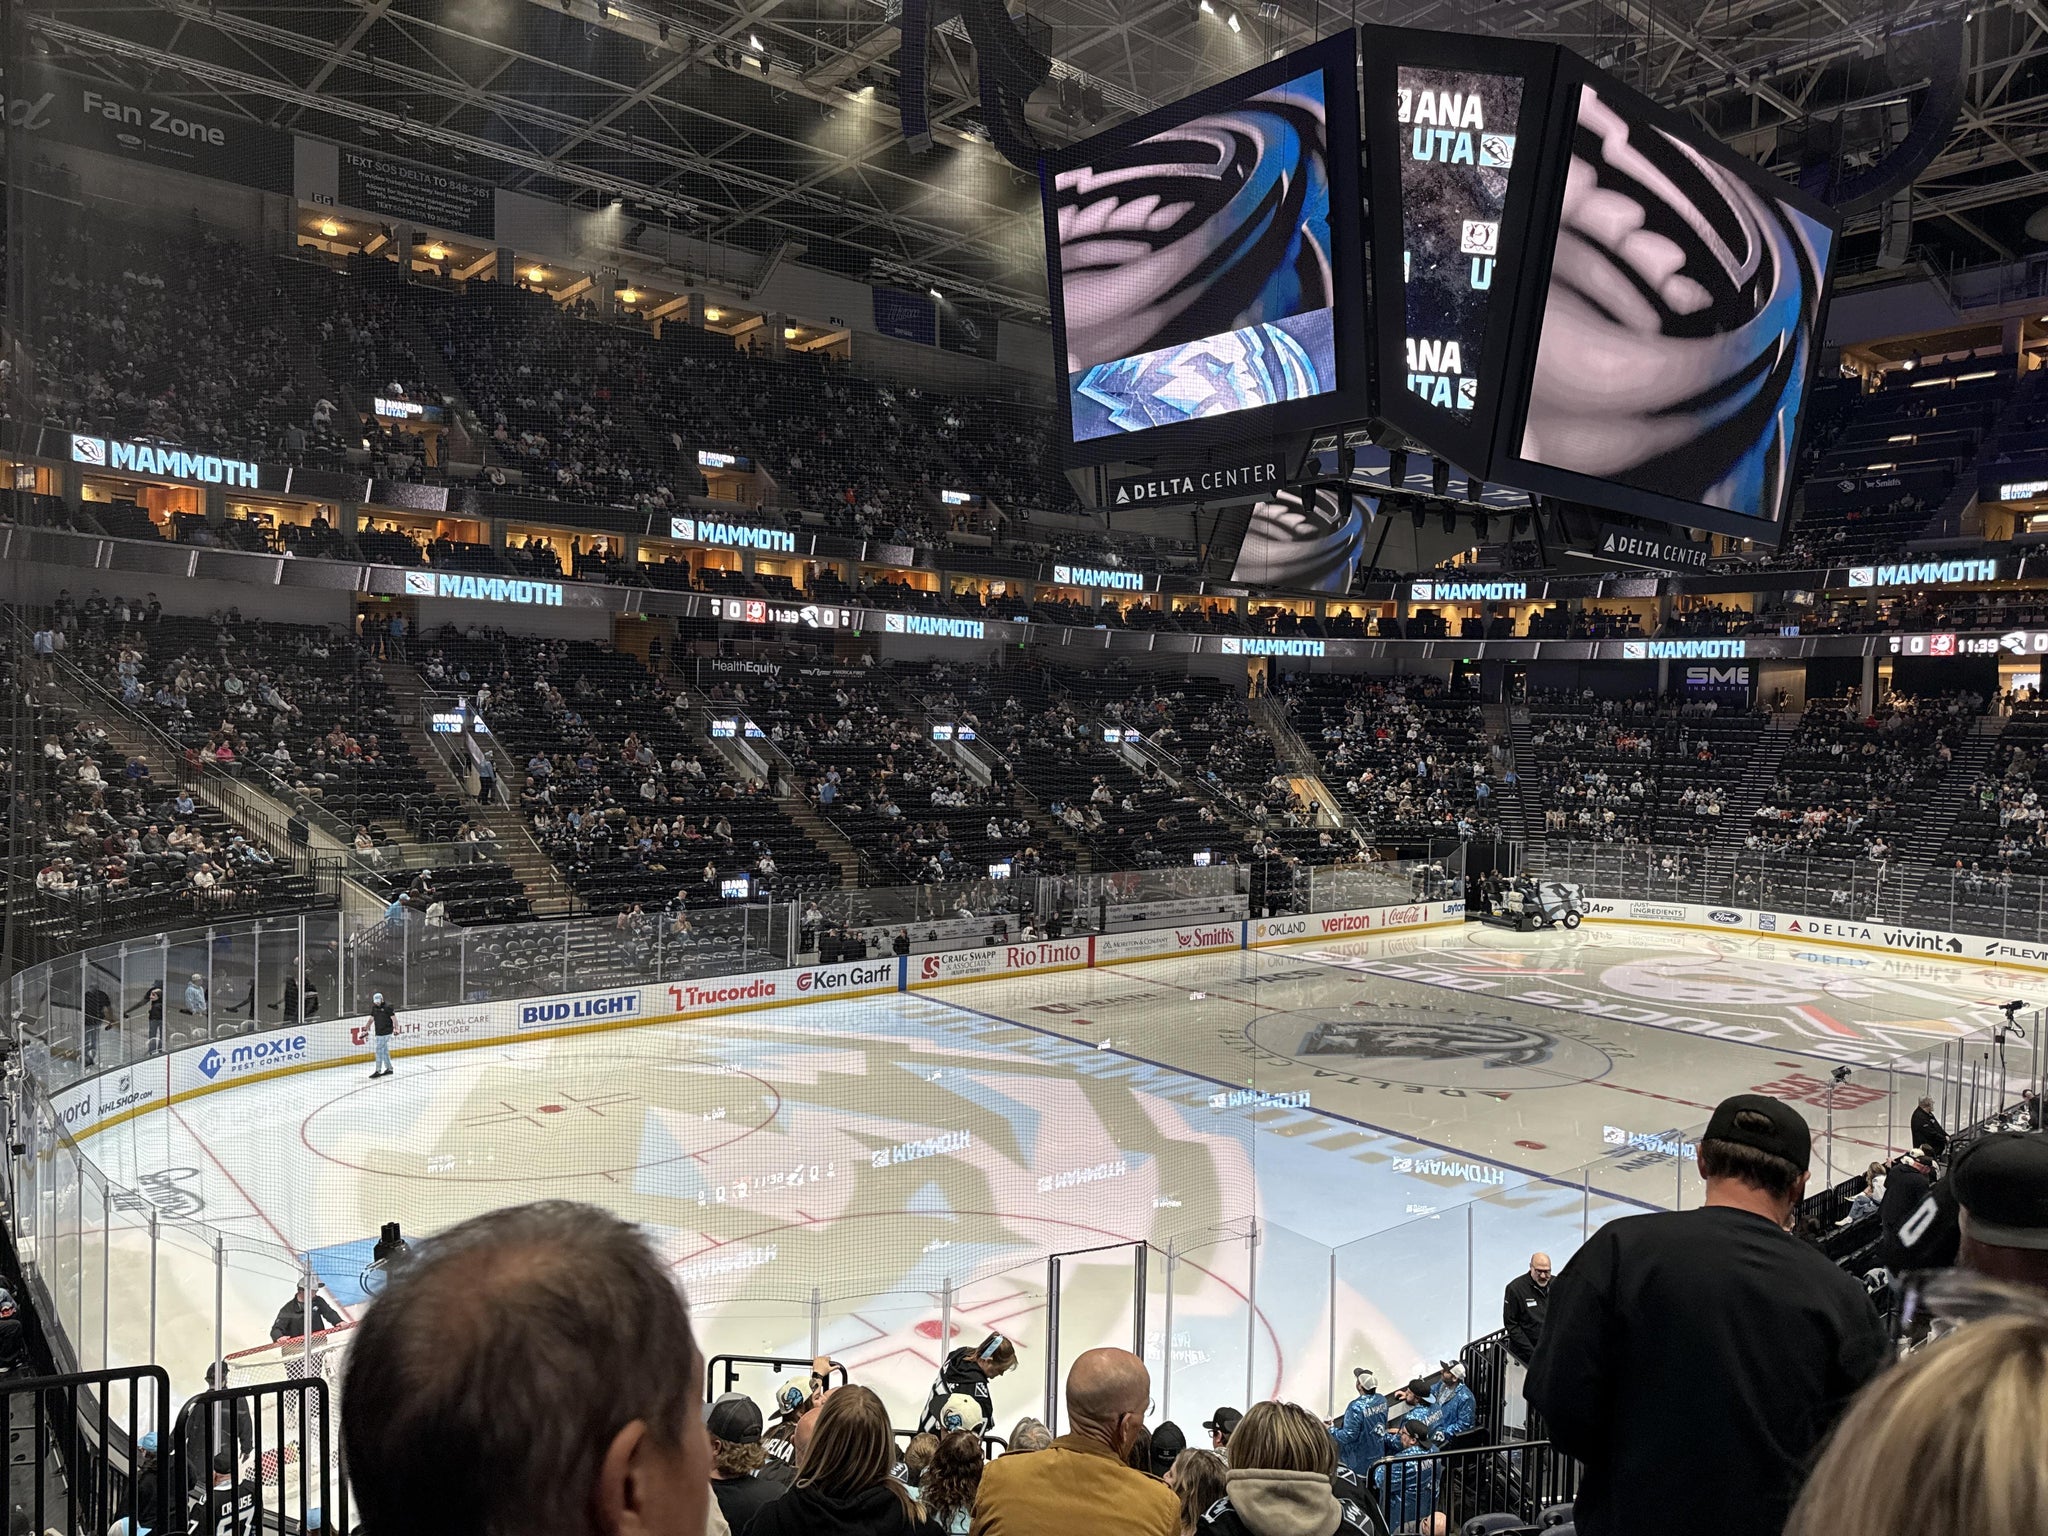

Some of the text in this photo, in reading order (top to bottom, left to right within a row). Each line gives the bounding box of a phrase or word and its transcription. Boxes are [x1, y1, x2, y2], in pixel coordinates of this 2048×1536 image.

[83, 91, 225, 146] Fan Zone
[1414, 91, 1484, 130] ANA
[1412, 127, 1474, 165] UTA
[345, 153, 490, 199] TEXT SOS DELTA TO 848-261
[314, 193, 332, 205] GG
[376, 201, 392, 210] TEXT
[1471, 257, 1496, 290] U
[386, 407, 408, 419] UTAH
[111, 441, 259, 489] MAMMOTH
[1133, 463, 1277, 500] DELTA CENTER
[2011, 490, 2033, 499] UTAH
[698, 520, 795, 552] MAMMOTH
[1618, 536, 1707, 567] DELTA CENTER
[1072, 567, 1144, 591] MAMMOTH
[1877, 559, 1996, 586] MAMMOTH
[439, 573, 564, 606] MAMMOTH
[1435, 582, 1527, 600] MAMMOTH
[729, 602, 741, 618] 0
[768, 608, 799, 624] 11:39
[824, 610, 835, 626] 0
[907, 615, 985, 639] MAMMOTH
[1242, 638, 1325, 657] MAMMOTH
[1648, 640, 1746, 659] MAMMOTH
[1910, 637, 1924, 653] 0
[1958, 638, 1999, 654] 11:39
[712, 659, 780, 676] HealthEquity
[1322, 913, 1370, 933] verizon
[1633, 907, 1683, 917] INGREDIENTS
[1193, 928, 1234, 947] Smith's
[1268, 921, 1306, 936] OKLAND
[1809, 922, 1871, 940] DELTA
[1884, 929, 1943, 952] vivint
[941, 950, 996, 964] CRAIG SWAPP
[951, 959, 991, 970] ASSOCIATES
[814, 964, 892, 990] Ken Garff
[685, 979, 776, 1006] Trucordia
[523, 996, 637, 1024] BUD LIGHT
[427, 1015, 489, 1029] OFFICIAL CARE
[427, 1025, 470, 1037] PROVIDER
[231, 1035, 307, 1064] moxie
[231, 1051, 307, 1072] PEST CONTROL
[1314, 1069, 1468, 1098] DELTA
[222, 1494, 252, 1516] CRUSE
